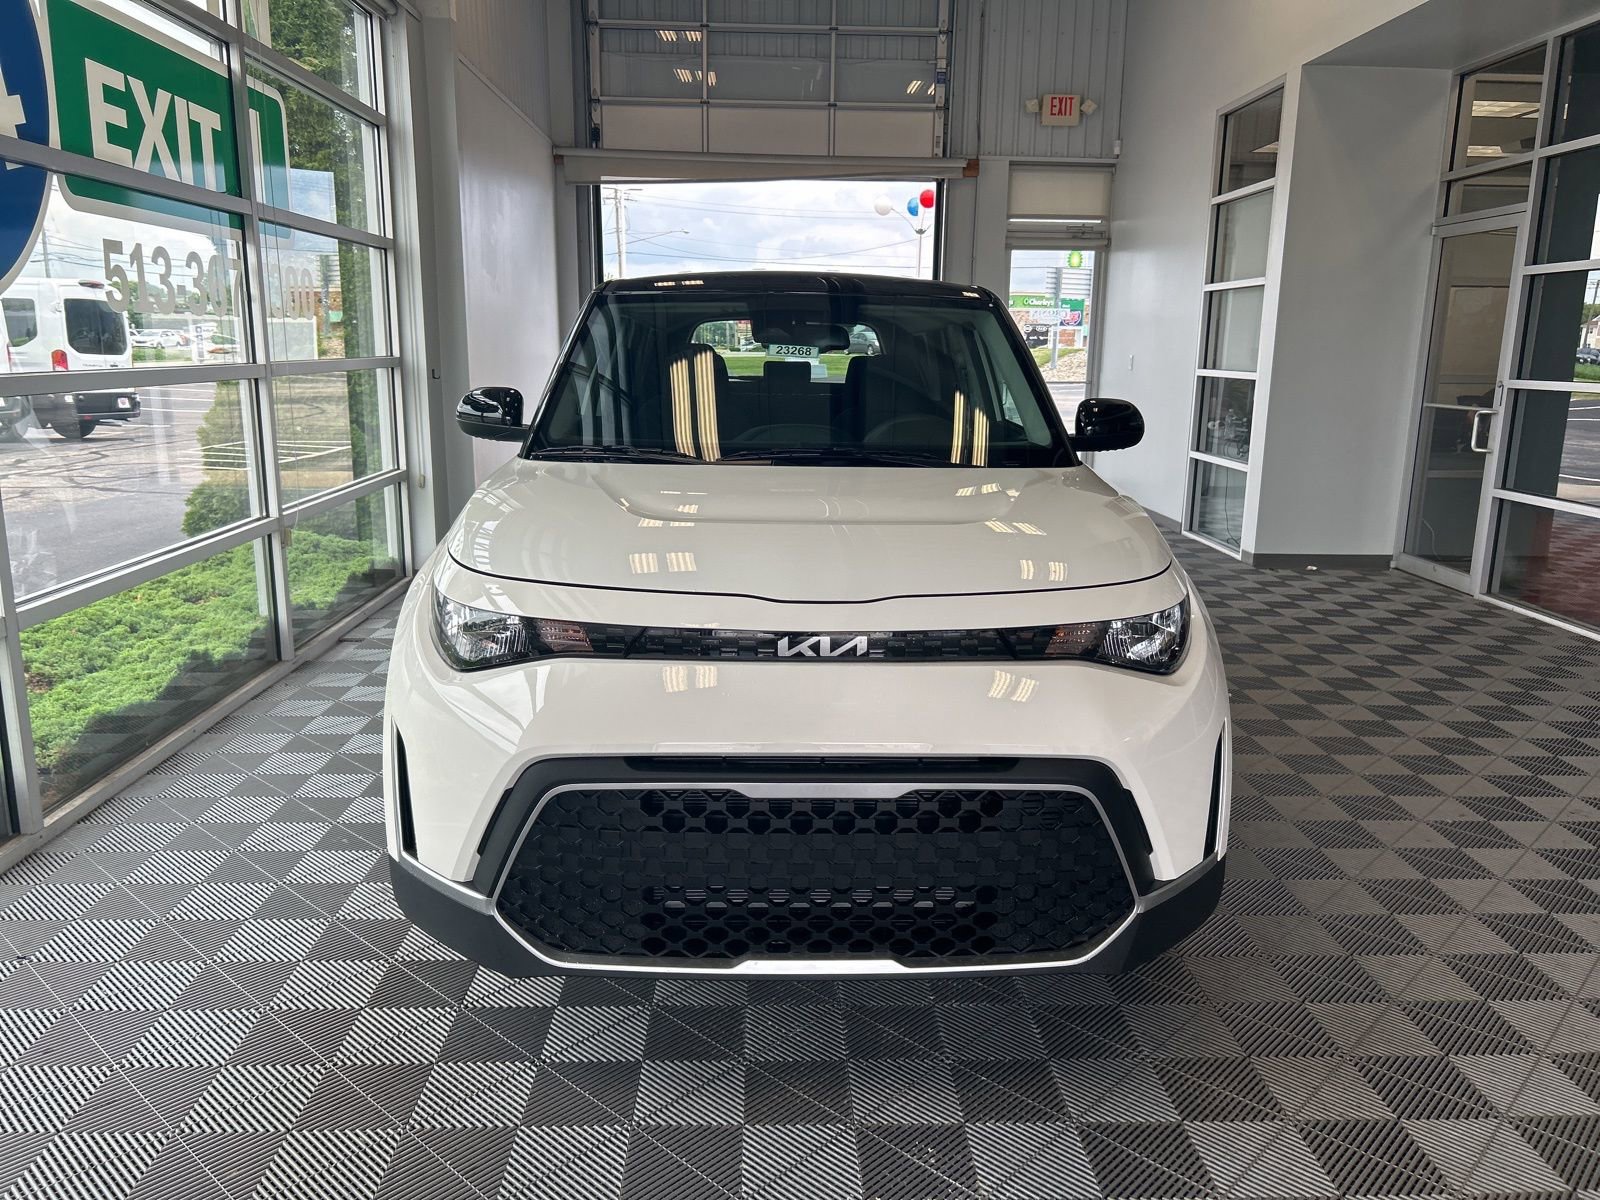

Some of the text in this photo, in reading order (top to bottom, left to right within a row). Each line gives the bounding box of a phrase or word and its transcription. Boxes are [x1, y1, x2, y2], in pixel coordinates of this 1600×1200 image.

[1050, 97, 1074, 116] EXIT
[85, 57, 222, 192] EXIT
[776, 345, 812, 356] 23268
[777, 635, 868, 657] KIA
